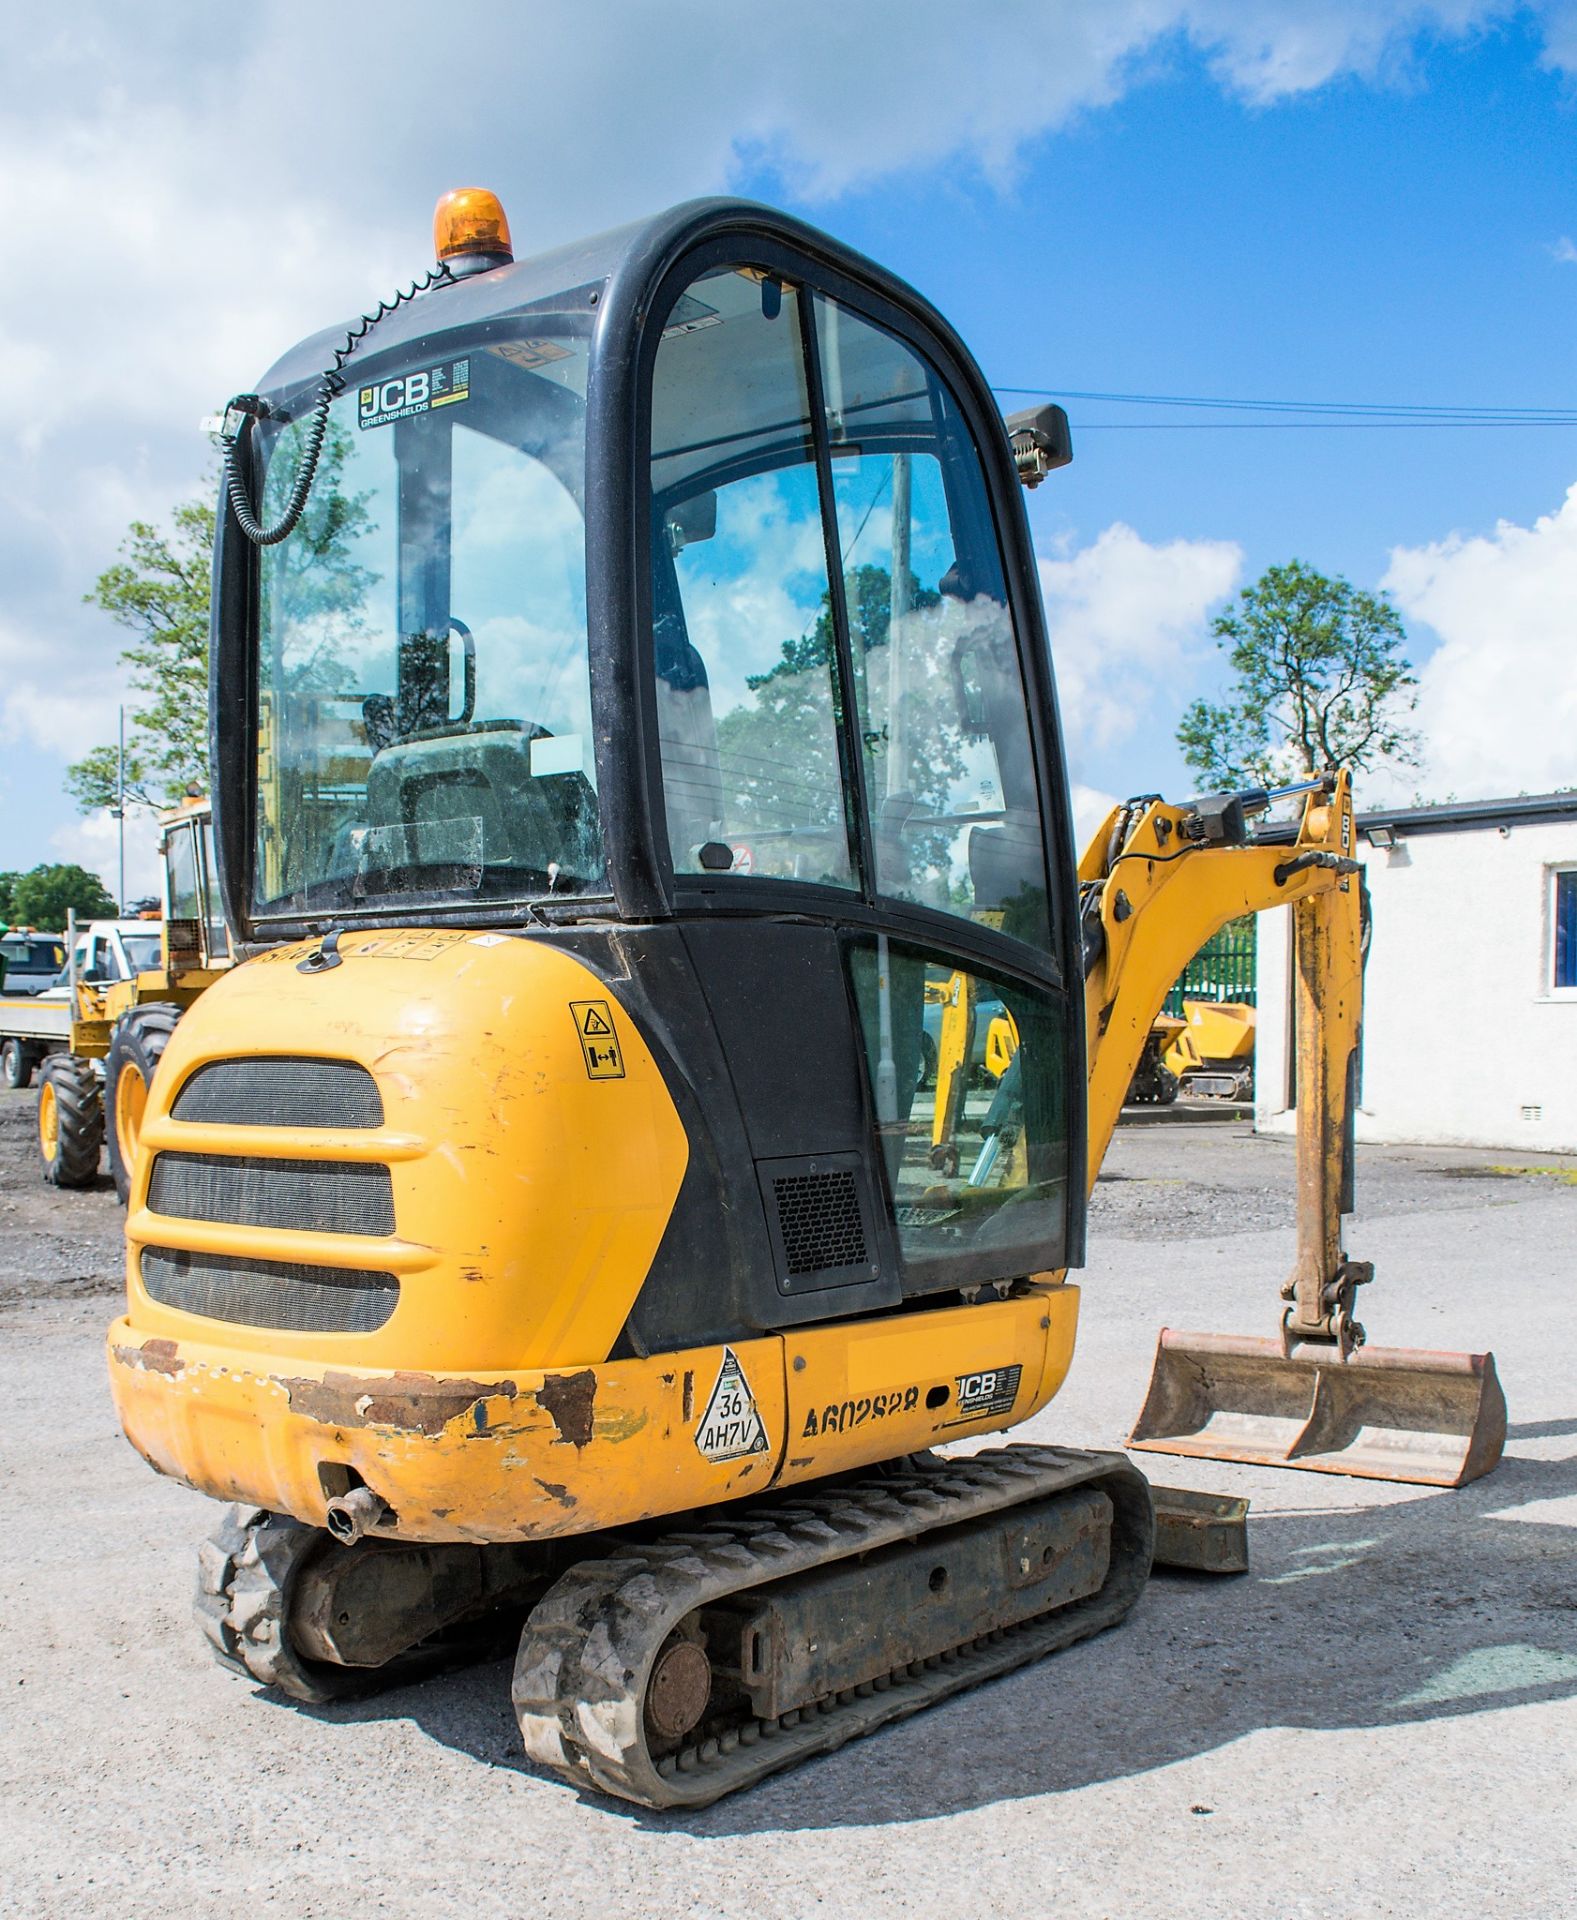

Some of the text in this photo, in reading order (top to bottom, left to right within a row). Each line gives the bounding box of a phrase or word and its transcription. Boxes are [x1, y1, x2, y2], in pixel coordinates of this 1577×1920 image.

[361, 372, 429, 418] JCB
[361, 402, 428, 428] GREENSHIELDS
[957, 1372, 997, 1399] JCB
[720, 1392, 742, 1418] 36
[703, 1419, 752, 1451] AH7V
